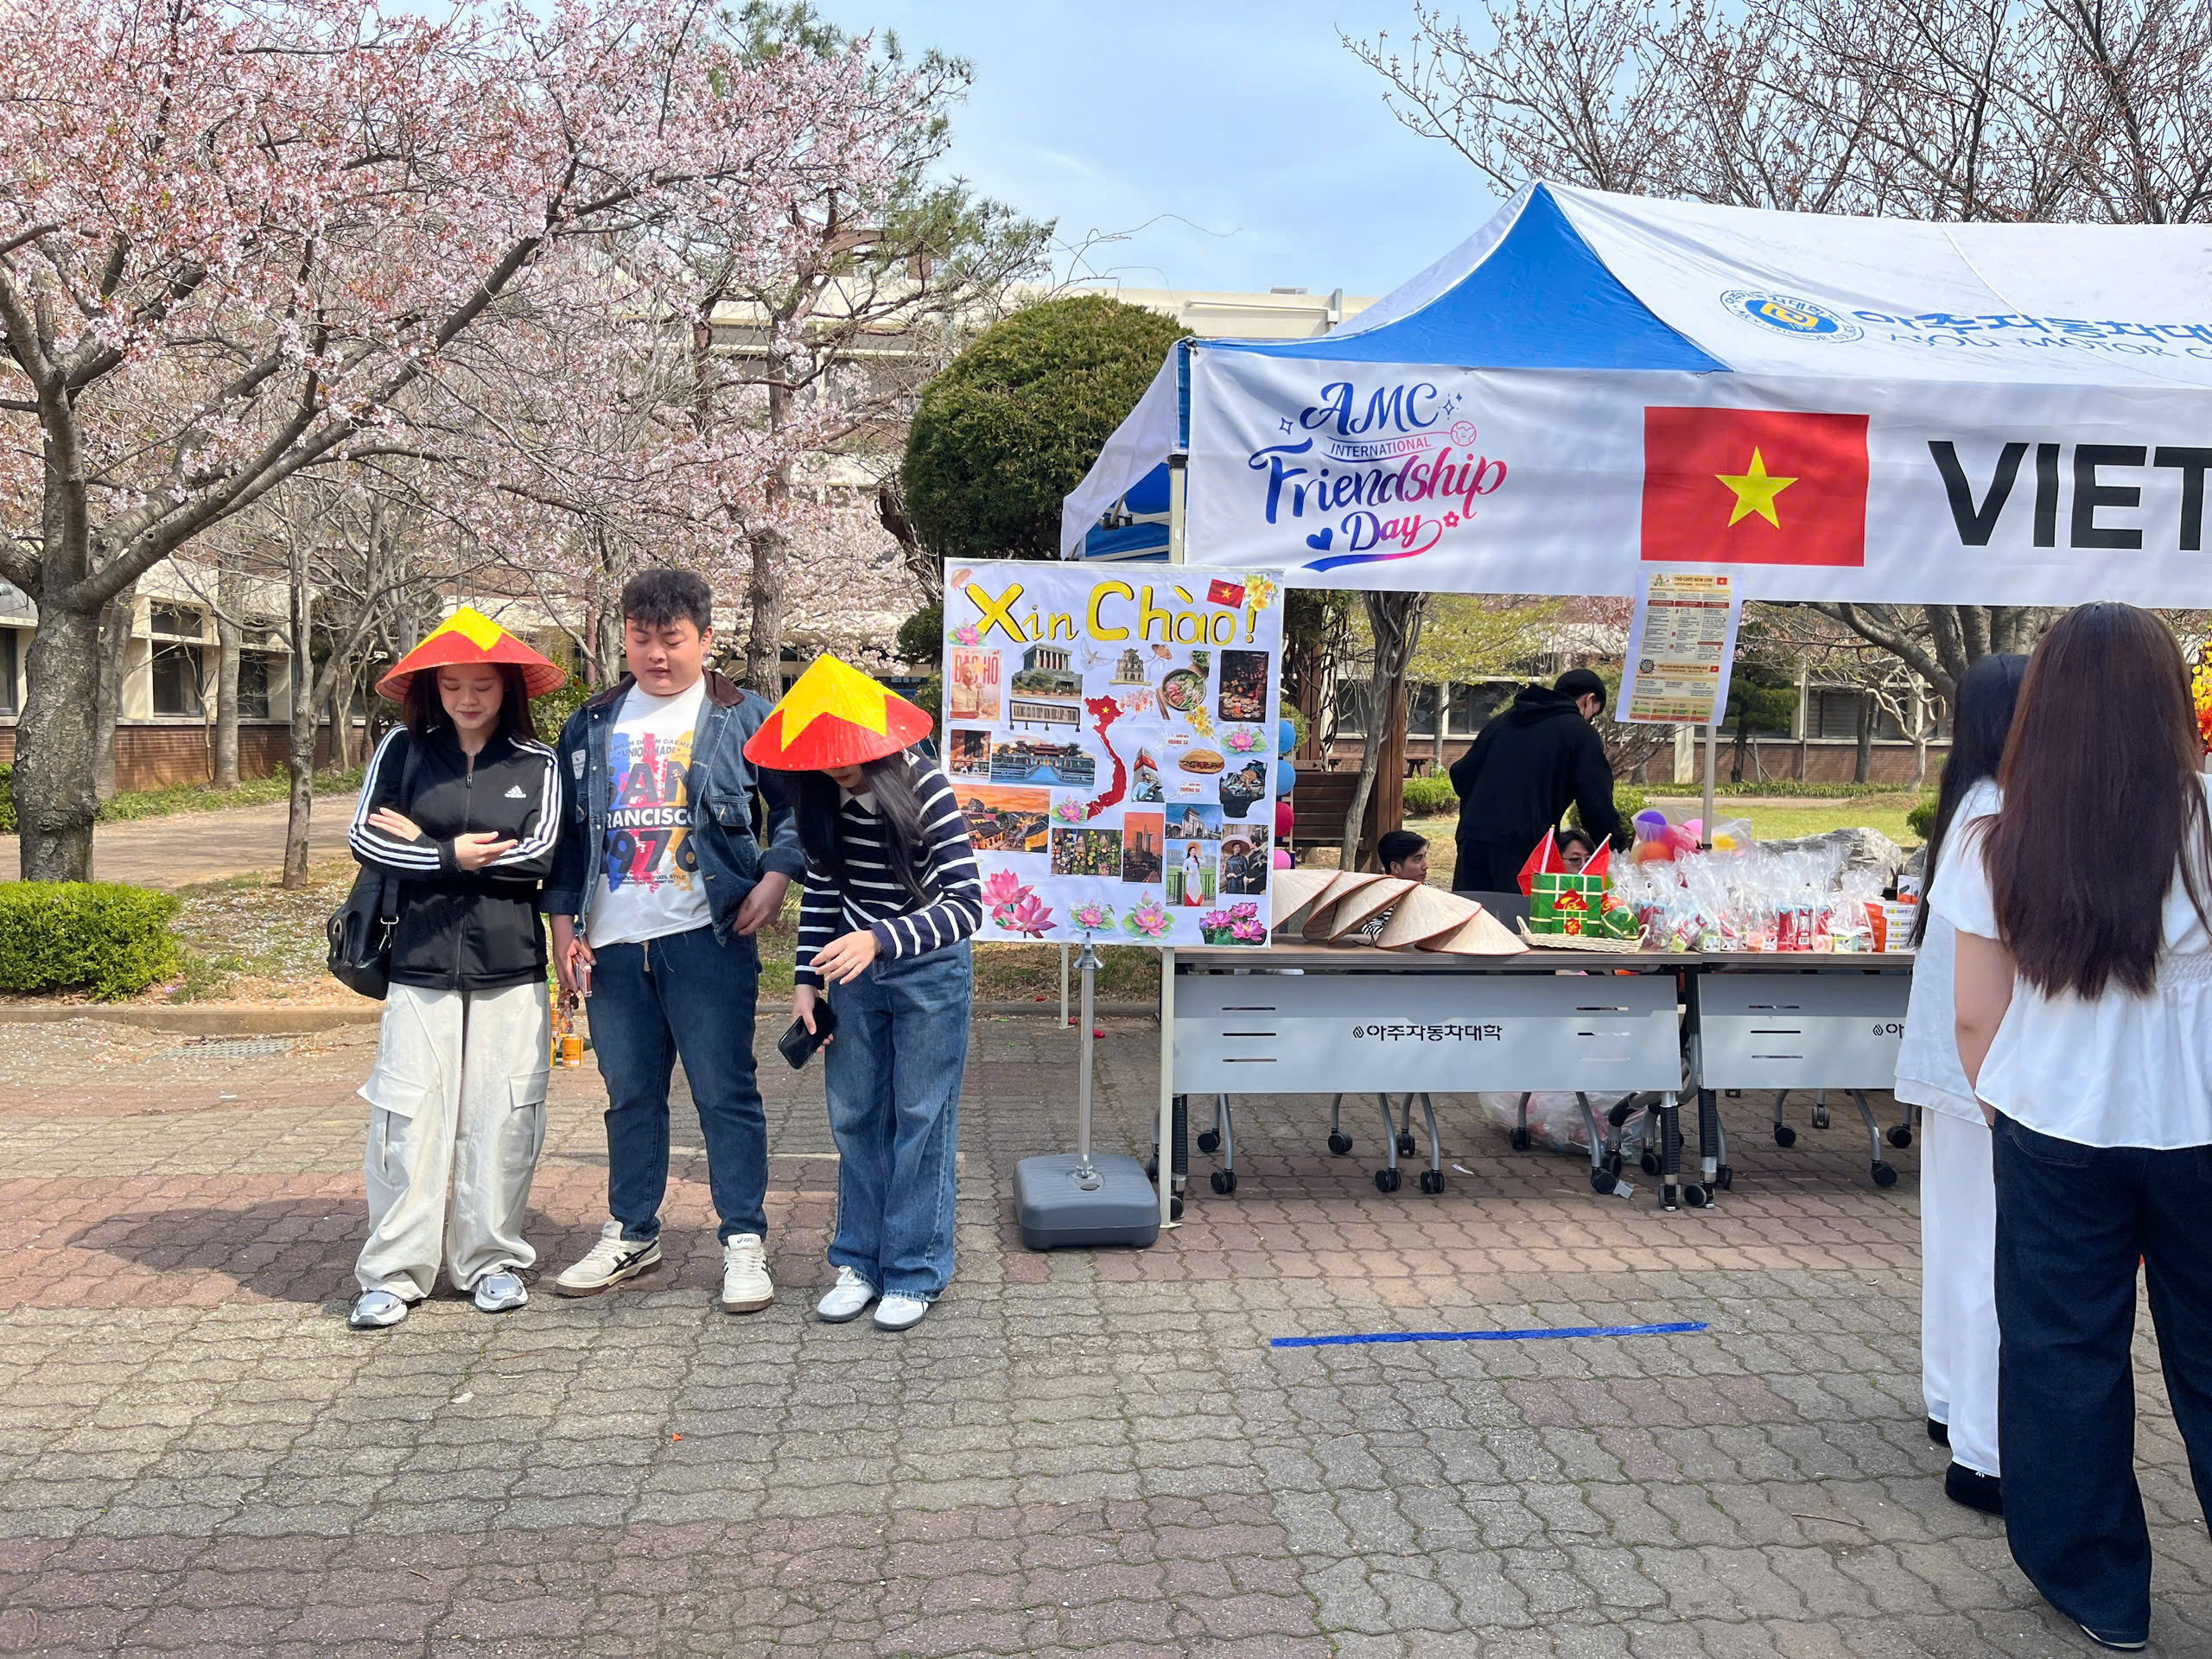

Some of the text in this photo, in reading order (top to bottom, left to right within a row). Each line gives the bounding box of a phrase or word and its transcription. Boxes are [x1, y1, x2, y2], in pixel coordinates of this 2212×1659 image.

[1851, 309, 2212, 345] 아주자동차대
[2185, 347, 2212, 359] C
[1300, 382, 1439, 435] AMC
[1330, 436, 1432, 457] INTERNATIONAL
[1249, 437, 1507, 524] Friendship
[1928, 441, 2212, 550] VIET
[1338, 511, 1442, 553] Day
[965, 580, 1256, 646] Xin Chào!
[1367, 1024, 1503, 1042] 아주자동차대학
[1885, 1023, 1904, 1039] 아
